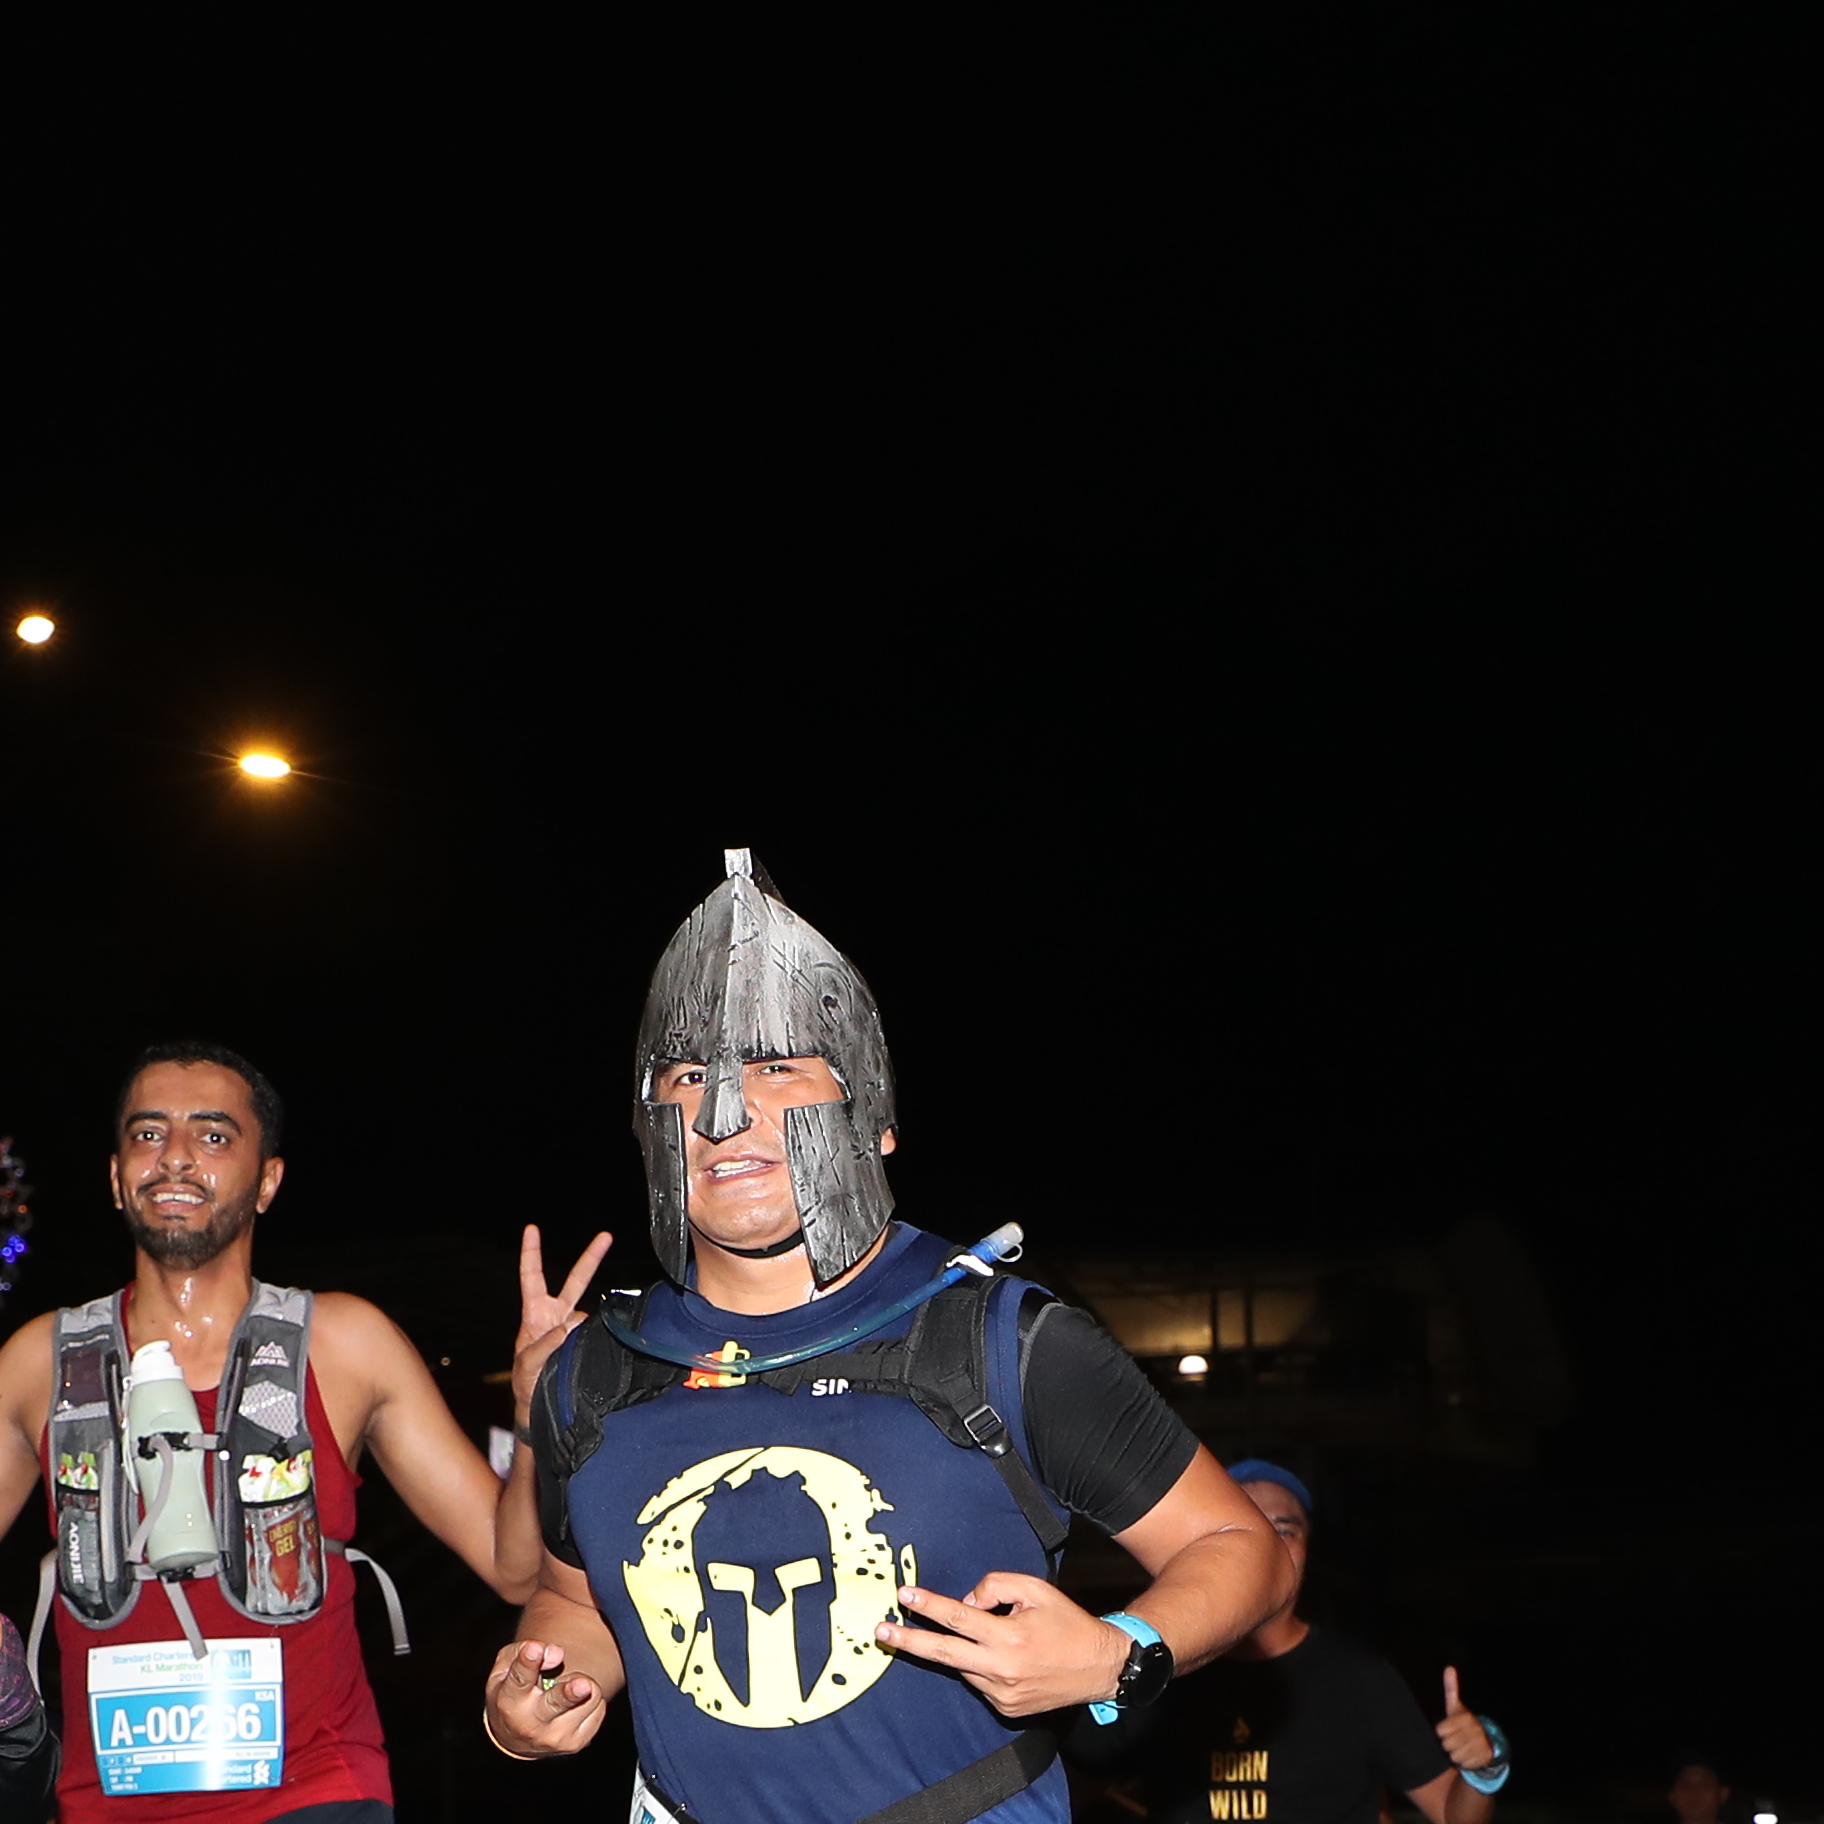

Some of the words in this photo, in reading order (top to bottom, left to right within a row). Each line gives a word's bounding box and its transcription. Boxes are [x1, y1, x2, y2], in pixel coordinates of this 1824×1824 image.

[152, 1650, 197, 1663] Chartere
[179, 1672, 204, 1683] 2019
[1210, 1750, 1269, 1782] BORN
[1209, 1789, 1269, 1820] WILD
